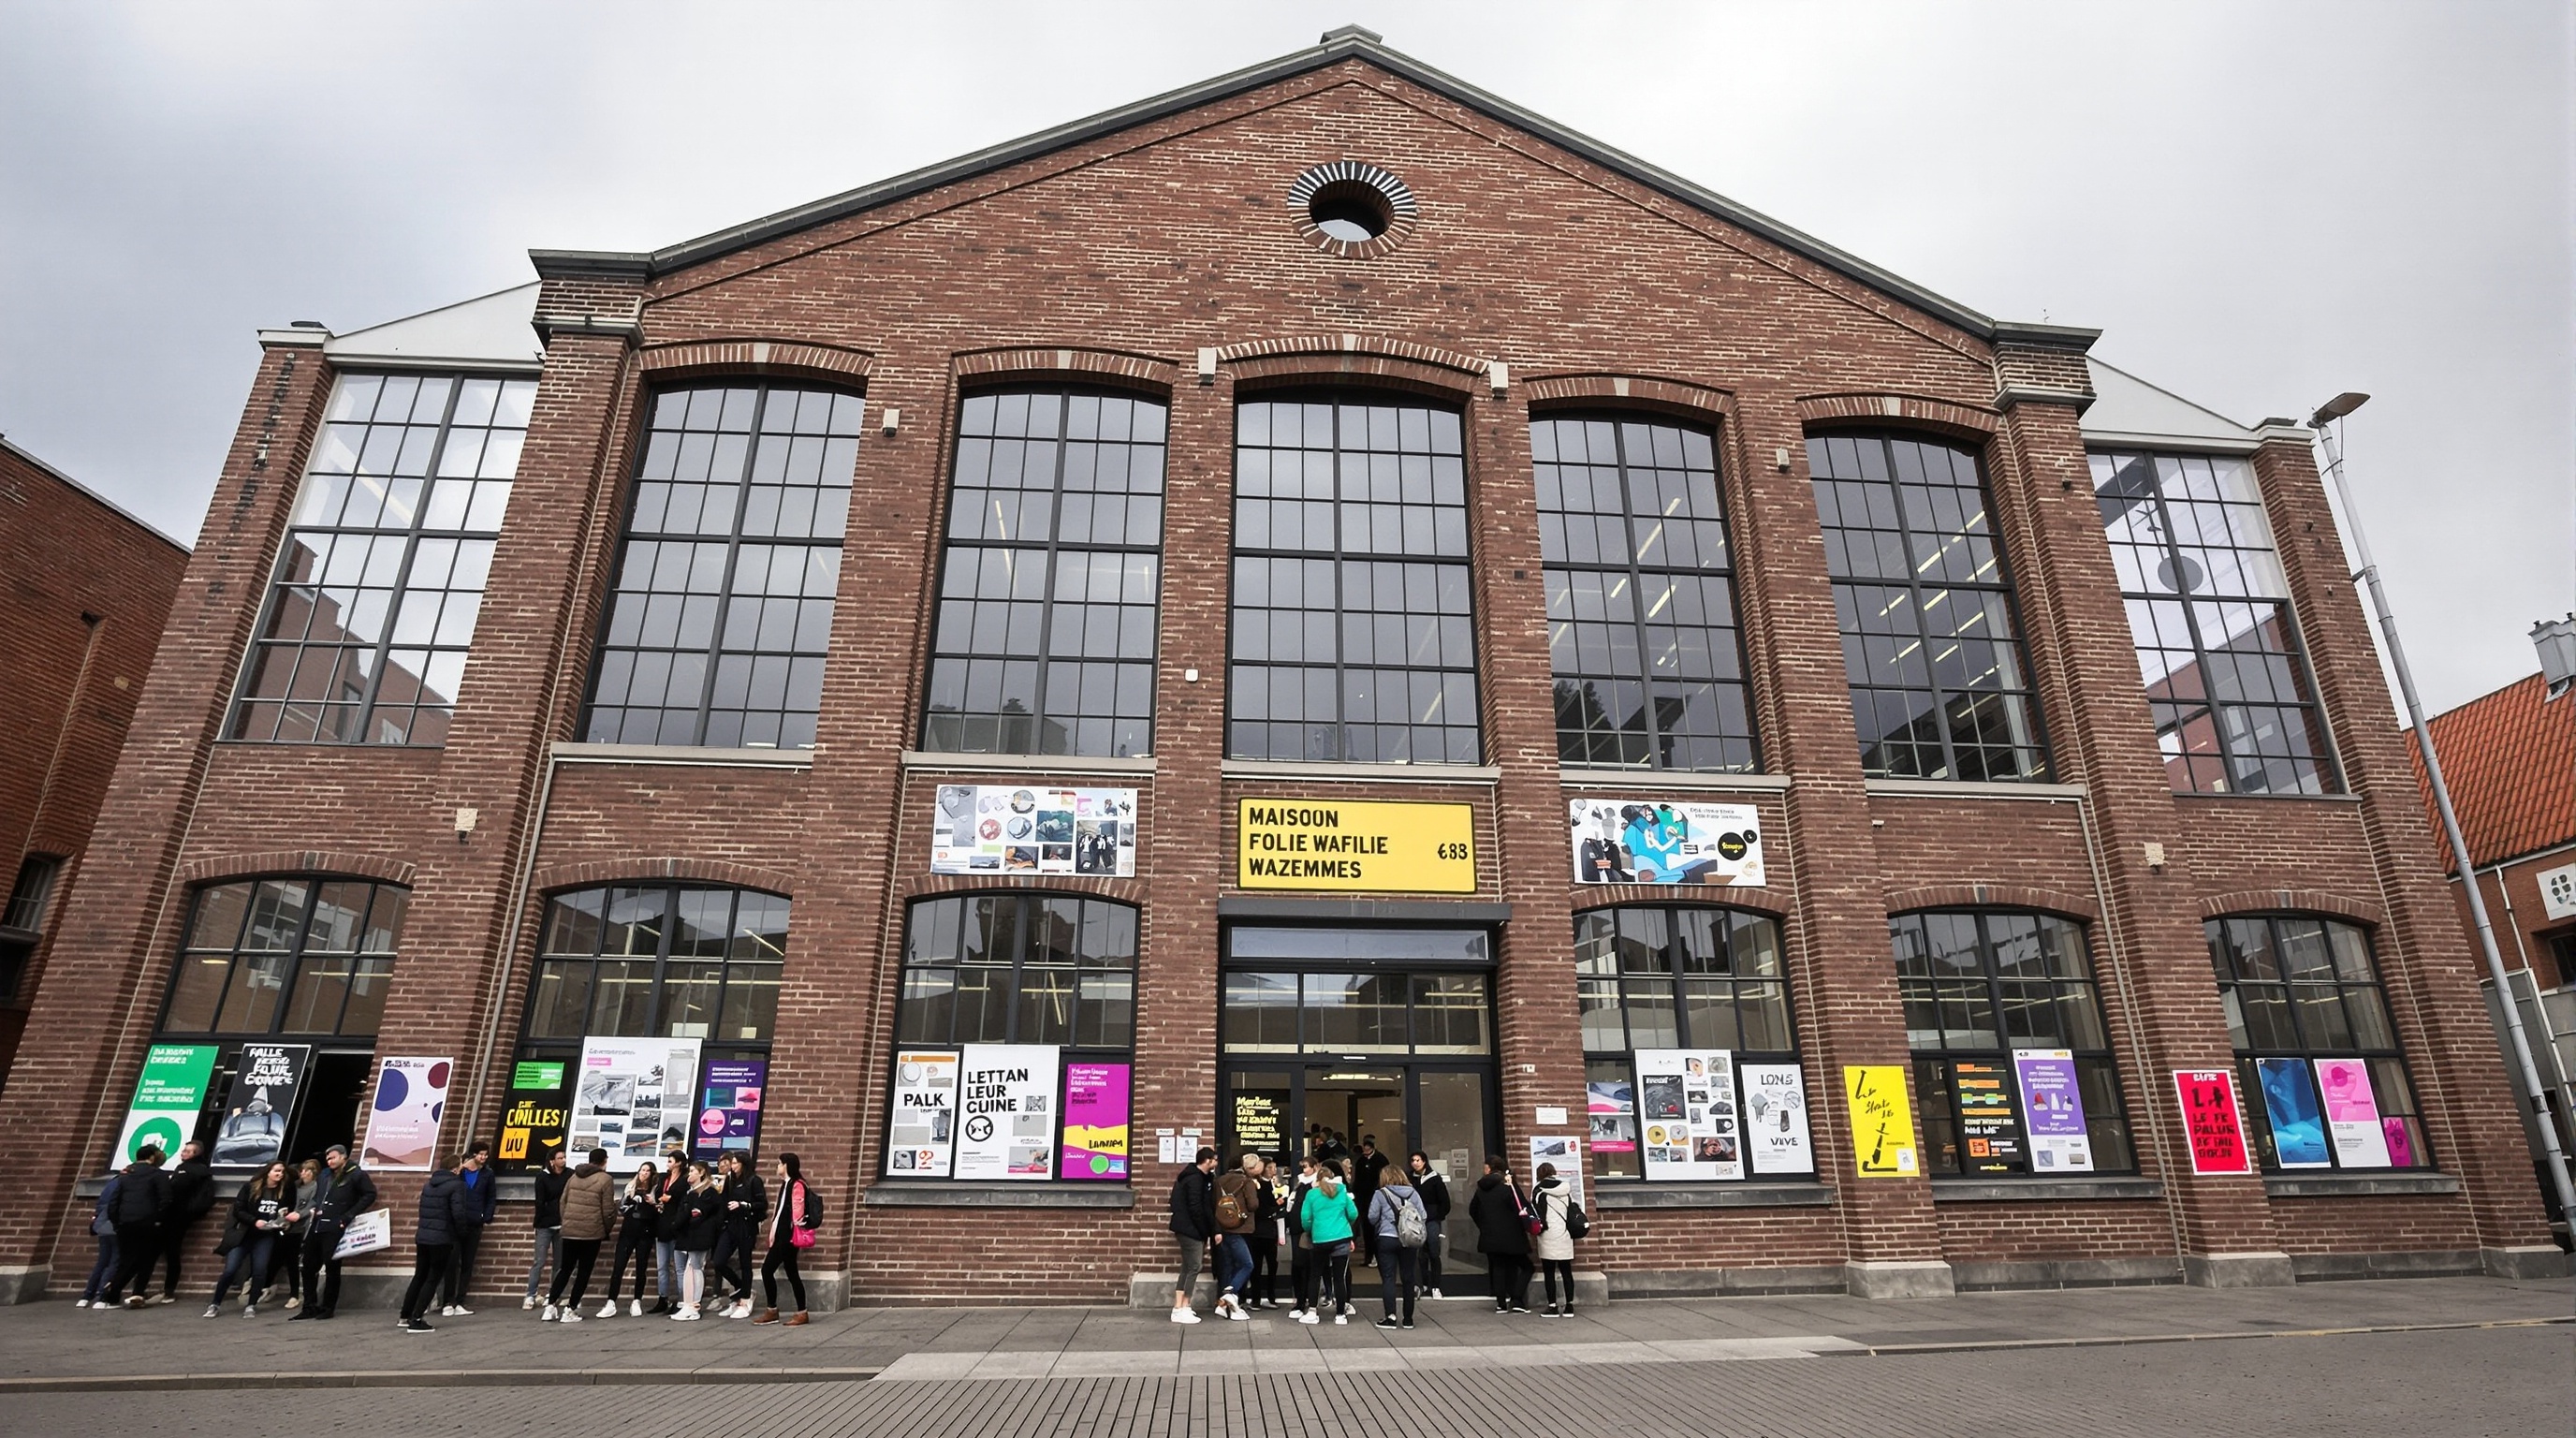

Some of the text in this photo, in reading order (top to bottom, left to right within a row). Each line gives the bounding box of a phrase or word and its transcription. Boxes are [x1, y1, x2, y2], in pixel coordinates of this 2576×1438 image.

[1249, 807, 1339, 828] MAISOON
[1250, 833, 1389, 855] FOLIE WAFILIE
[1249, 858, 1362, 878] WAZEMMES
[968, 1068, 1029, 1084] LETTAN
[903, 1093, 944, 1107] PALK
[967, 1084, 1007, 1099] LEUR
